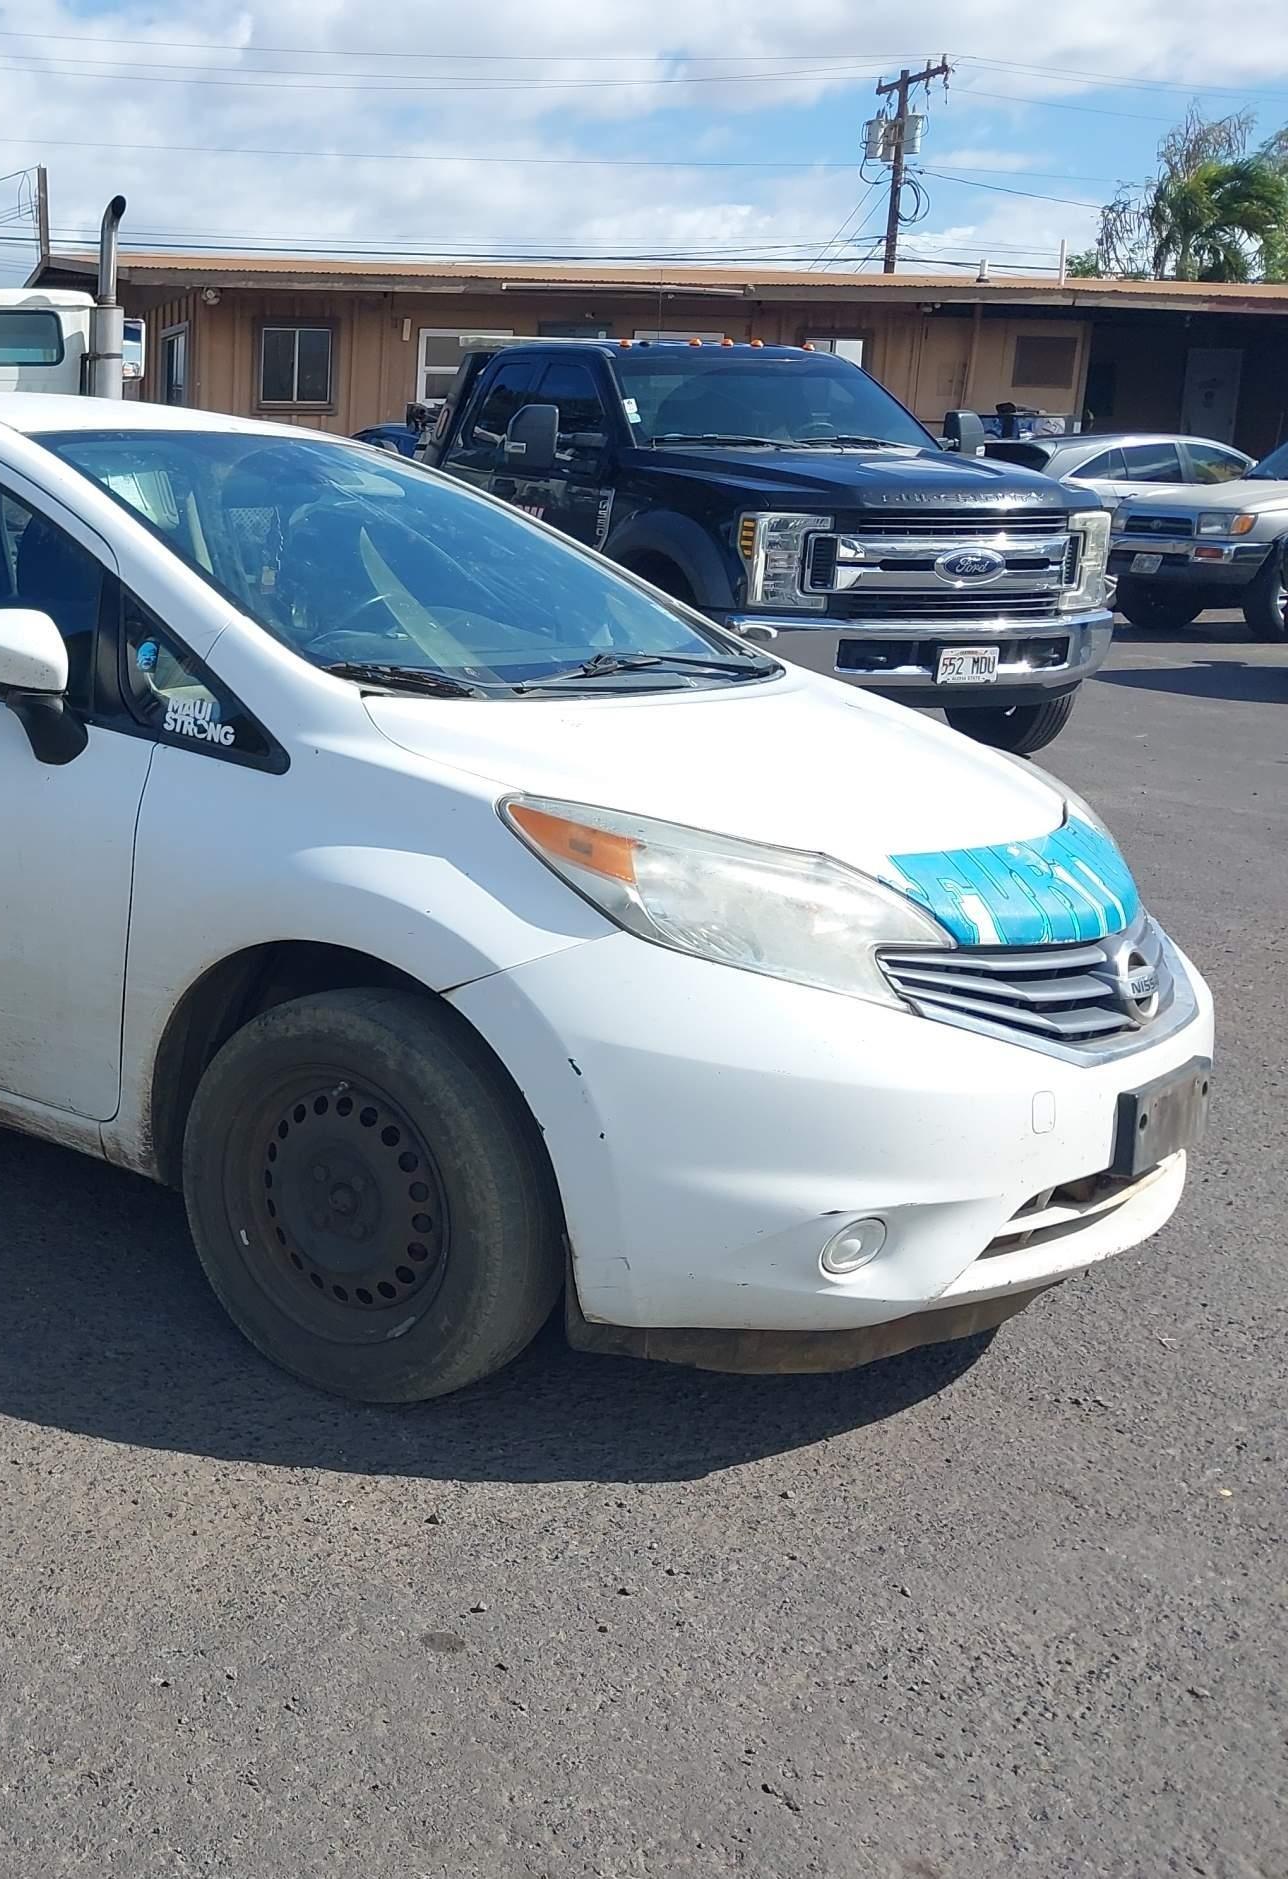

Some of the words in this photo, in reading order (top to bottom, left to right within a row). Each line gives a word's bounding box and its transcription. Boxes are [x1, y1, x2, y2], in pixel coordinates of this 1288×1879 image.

[955, 556, 990, 574] Ford
[941, 656, 964, 675] 552
[971, 656, 996, 675] MDU
[167, 697, 213, 722] MAUI
[163, 711, 236, 746] STRONG
[1131, 975, 1160, 995] NISS
